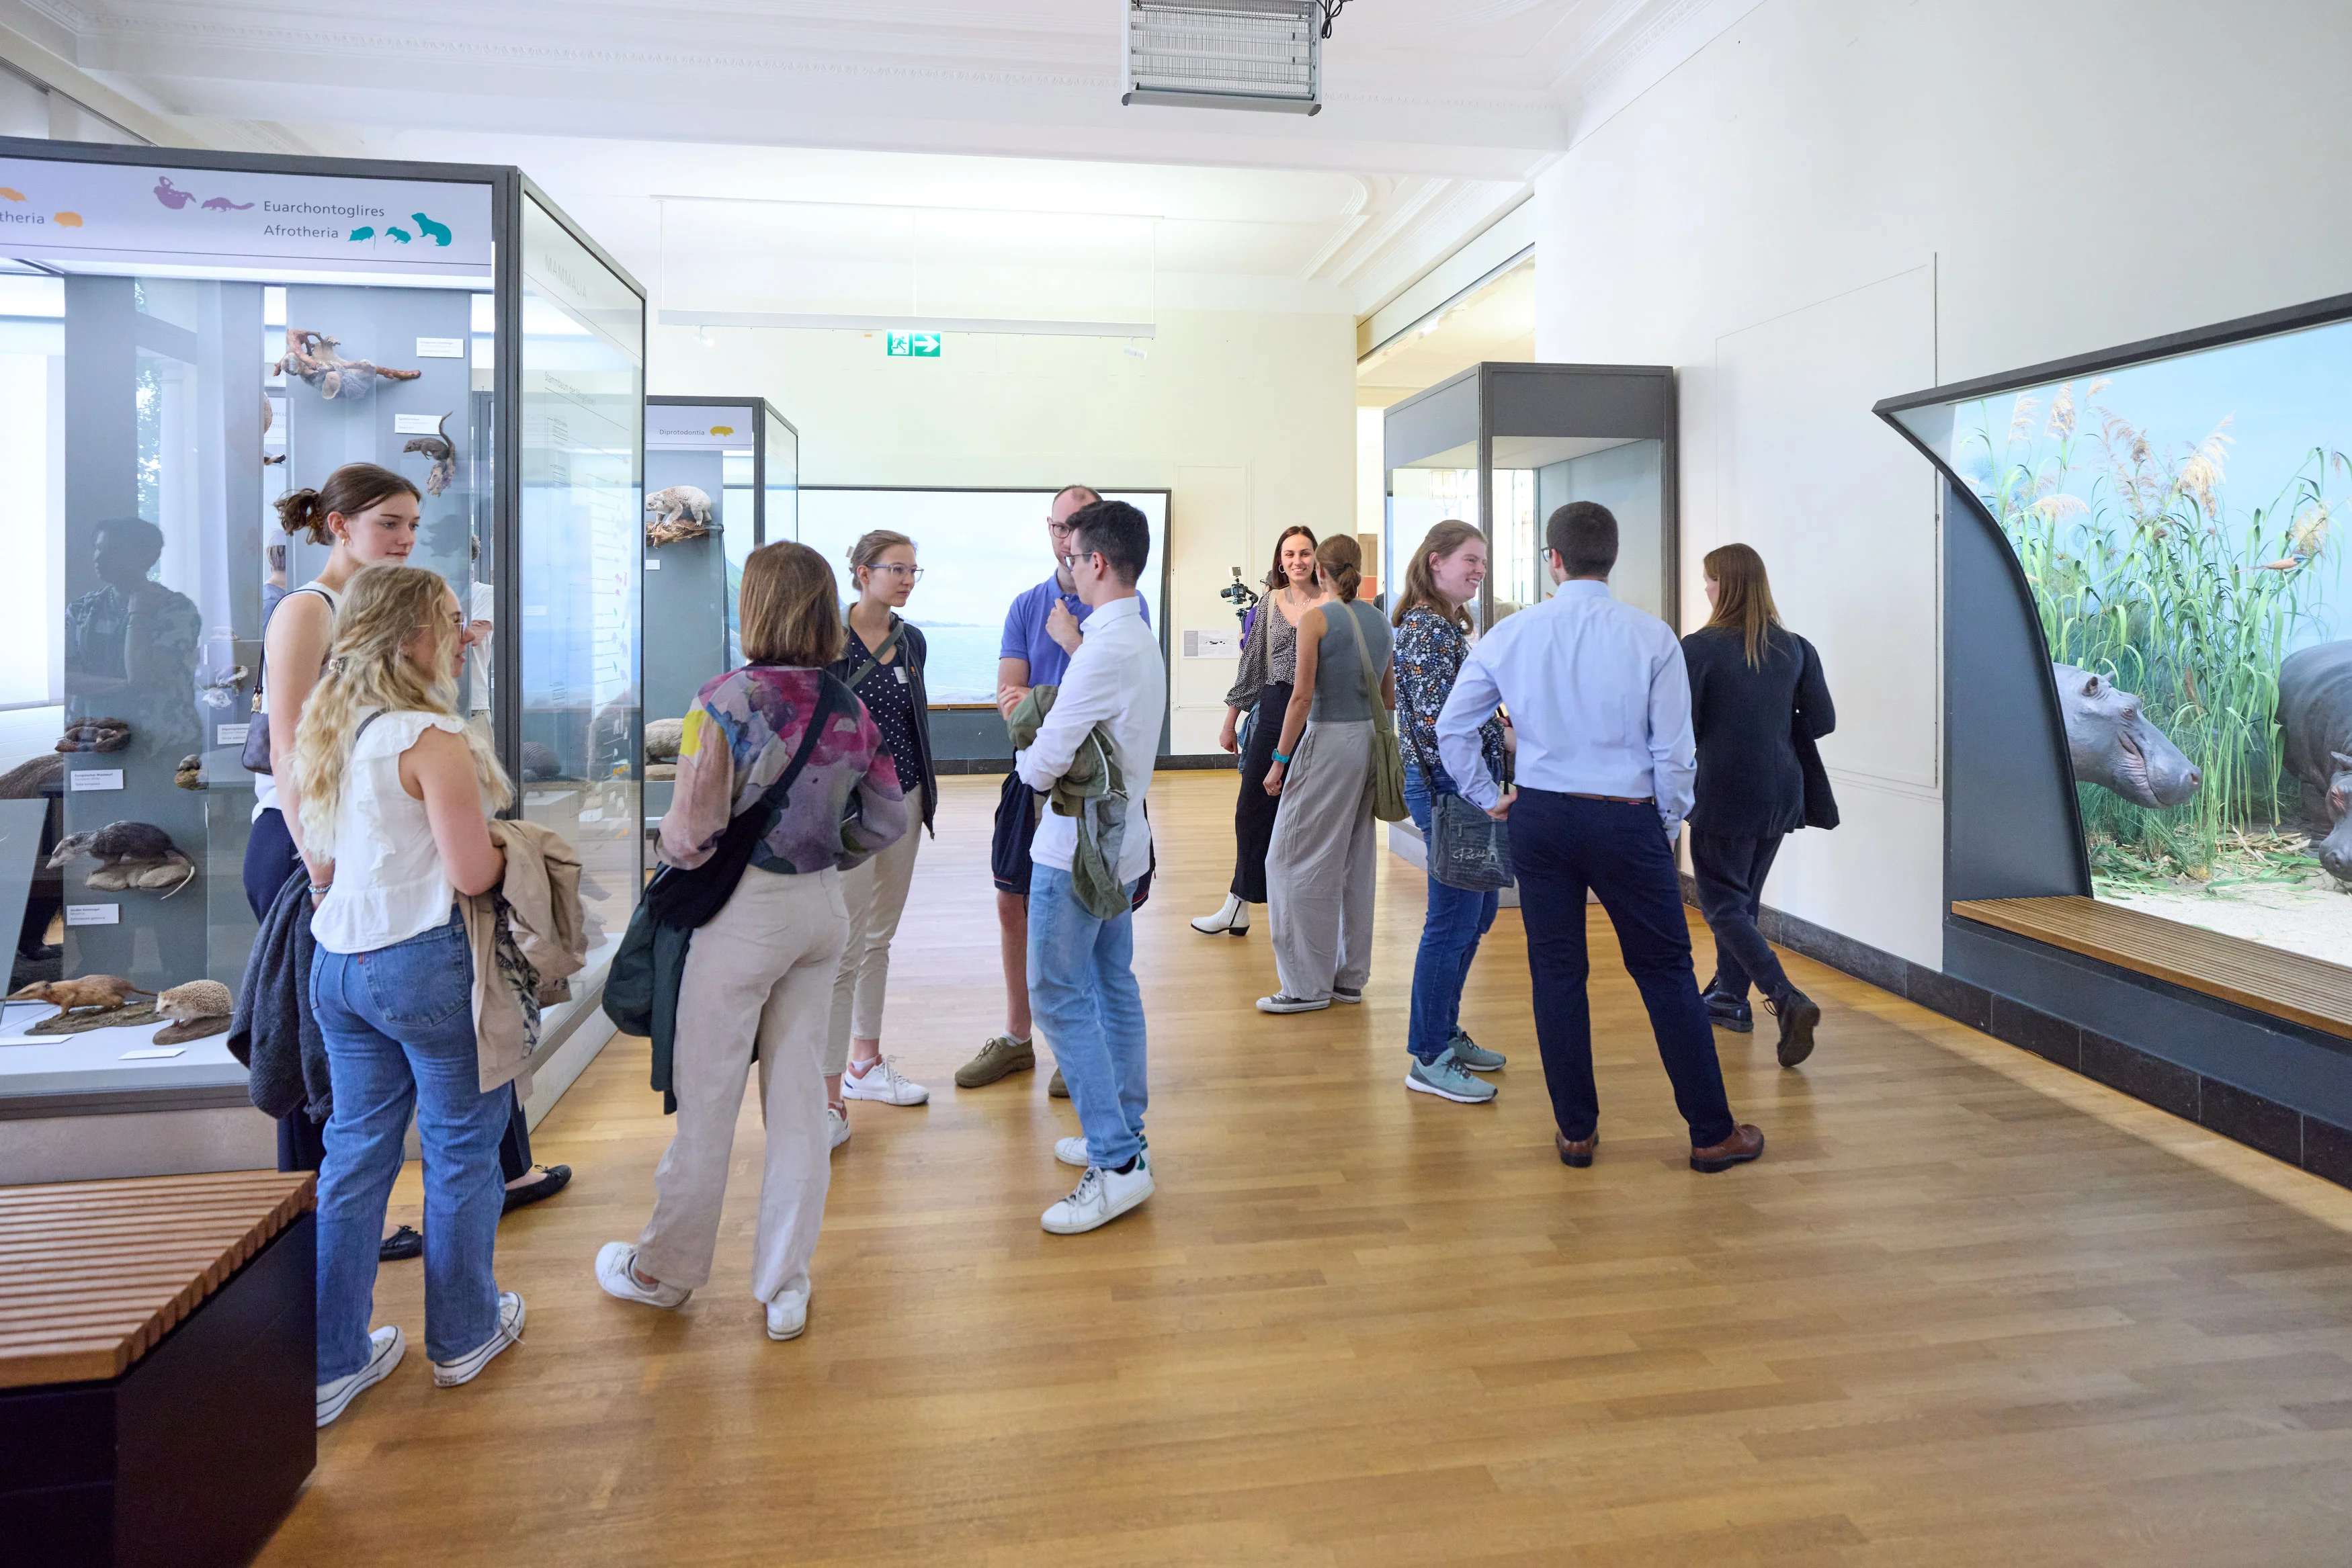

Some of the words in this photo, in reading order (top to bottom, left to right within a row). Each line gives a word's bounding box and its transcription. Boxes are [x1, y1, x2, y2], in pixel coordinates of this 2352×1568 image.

[264, 201, 385, 218] Euarchontoglires
[263, 225, 339, 238] Afrotheria
[545, 253, 587, 302] MAMMALIA
[544, 371, 569, 391] Stammbaum
